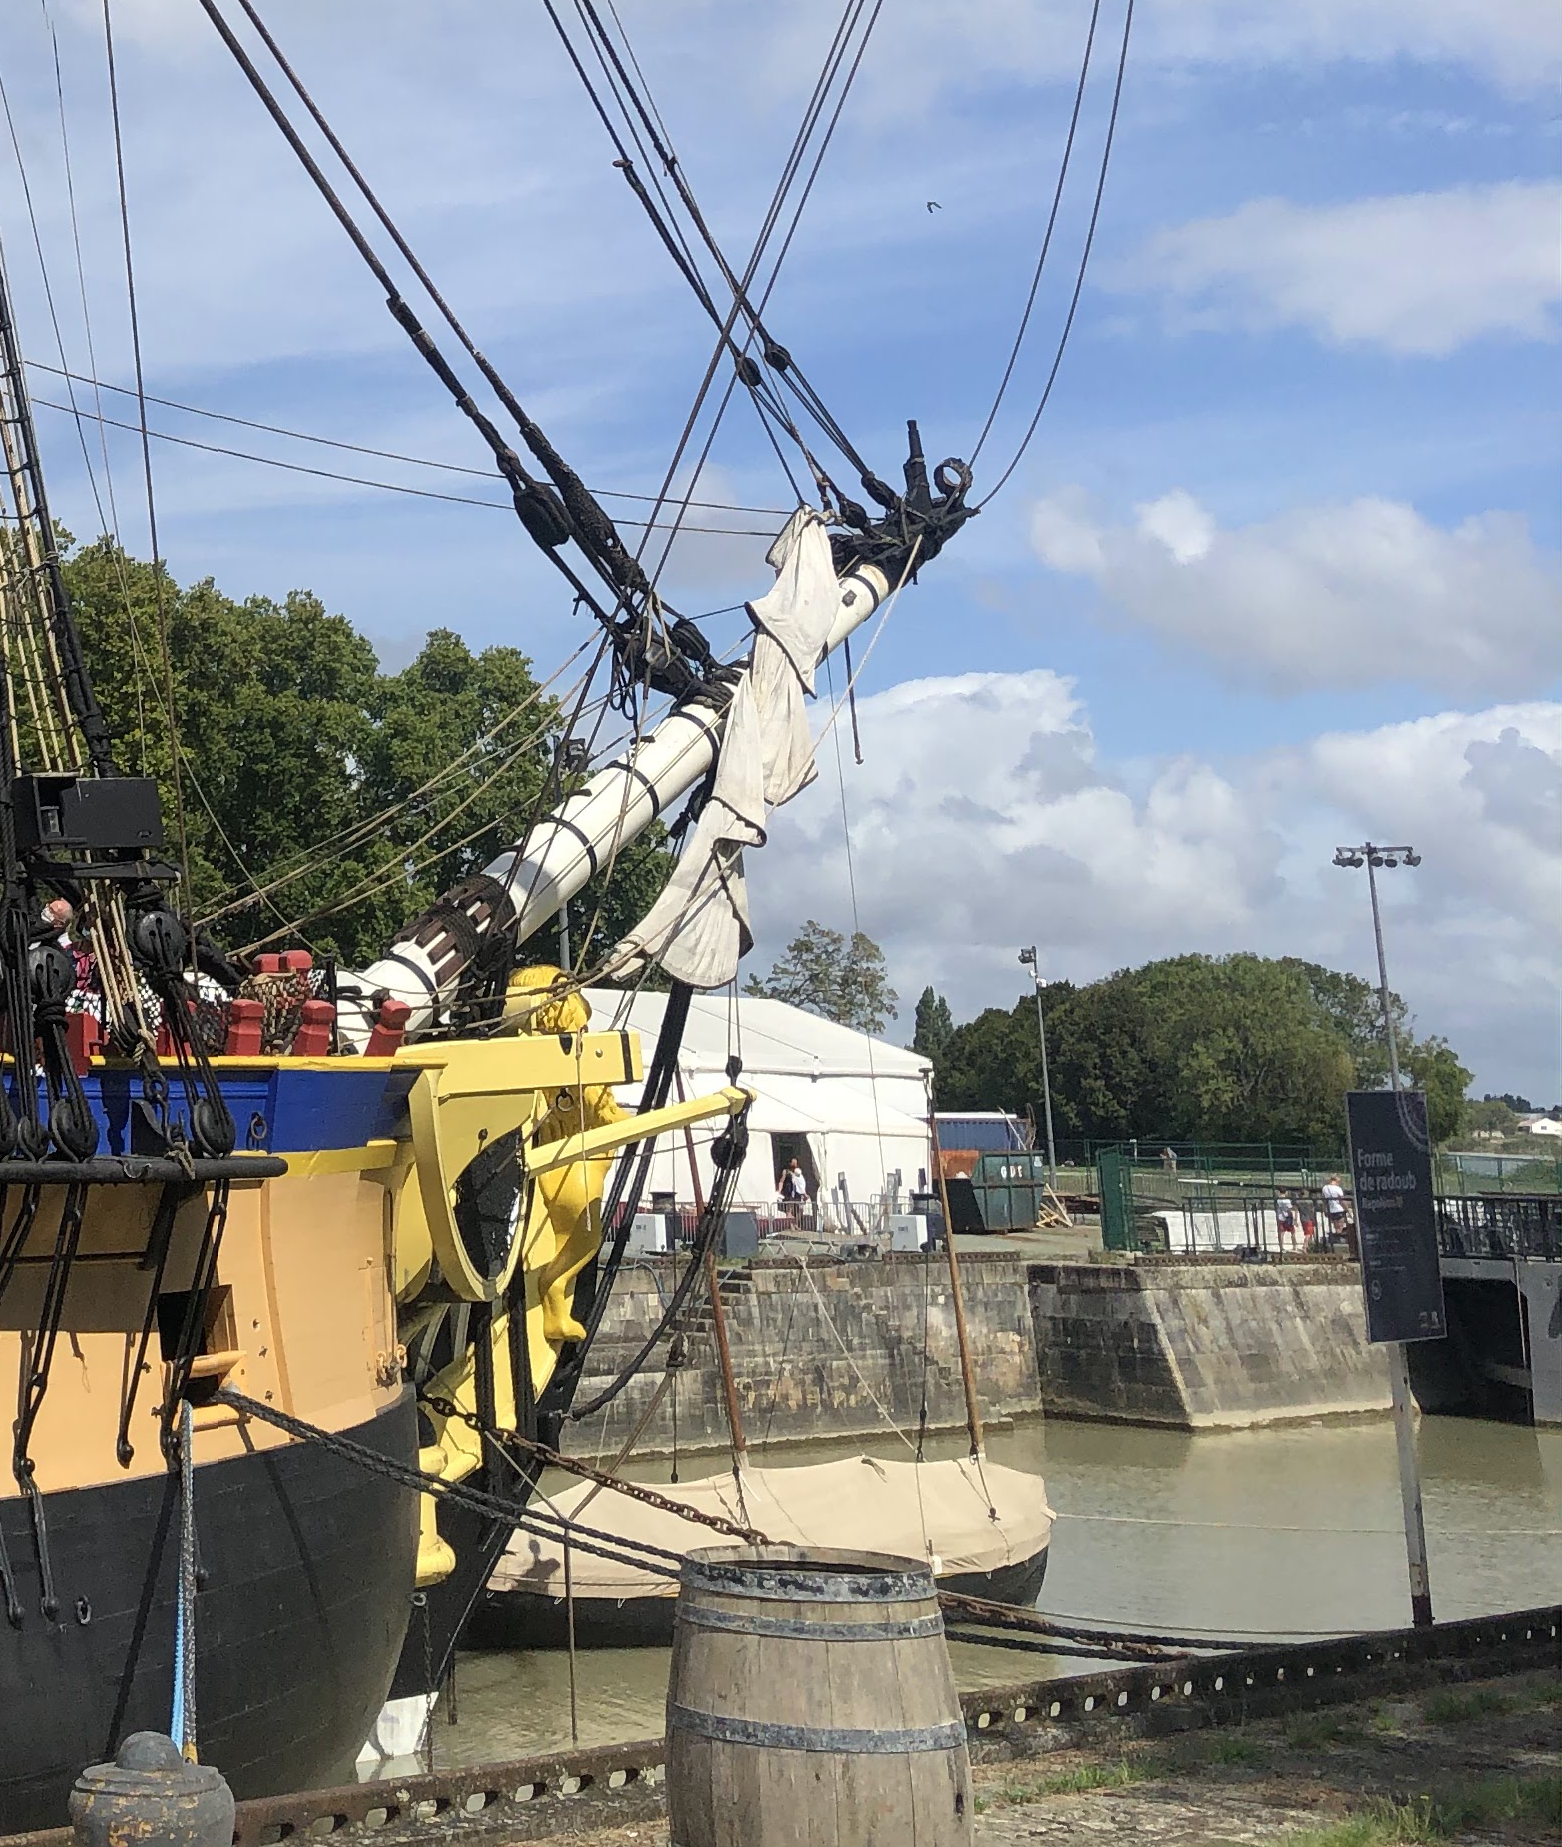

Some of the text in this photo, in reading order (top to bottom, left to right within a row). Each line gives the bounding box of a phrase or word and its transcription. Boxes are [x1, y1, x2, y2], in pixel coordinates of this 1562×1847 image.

[1358, 1148, 1394, 1167] Forme
[1359, 1171, 1417, 1190] de radoub
